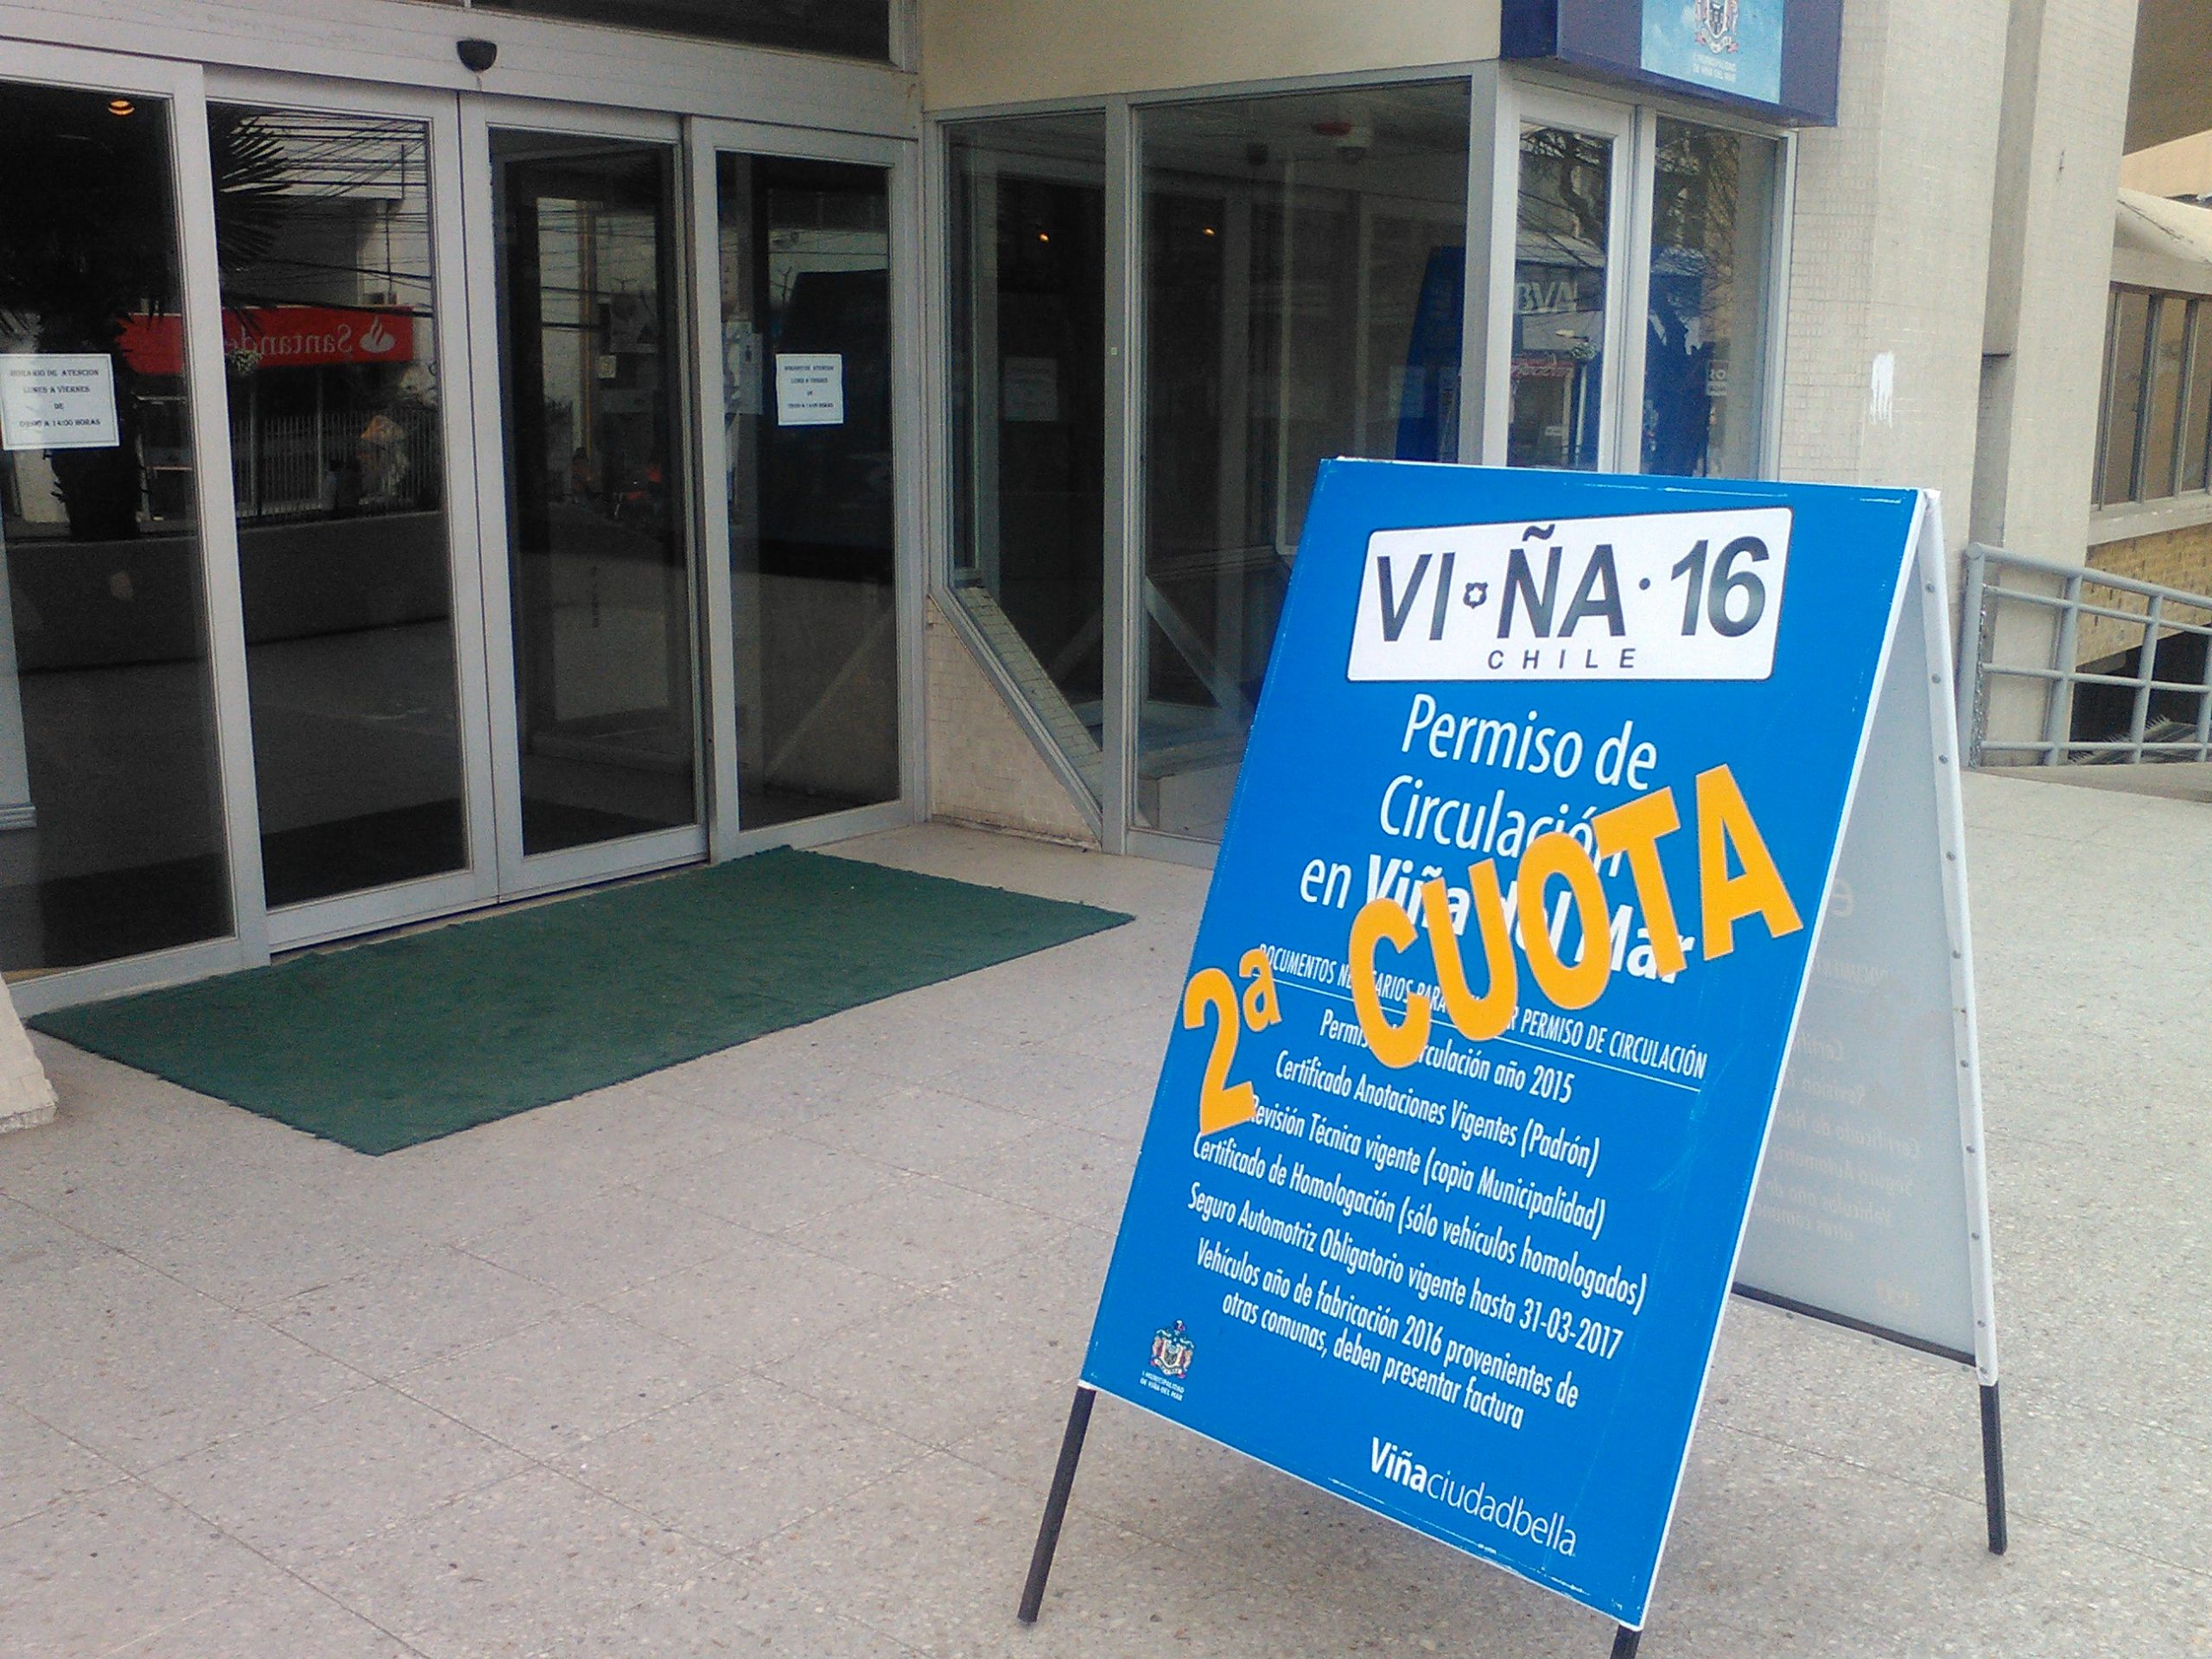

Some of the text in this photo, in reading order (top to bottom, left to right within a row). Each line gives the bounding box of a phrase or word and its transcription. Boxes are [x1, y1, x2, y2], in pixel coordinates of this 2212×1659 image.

[58, 385, 91, 394] VIERNES
[1487, 648, 1637, 670] CHILE
[1402, 693, 1657, 791] Permiso de
[1300, 857, 1351, 909] en
[1349, 763, 1803, 1068] CUOTA
[1319, 1008, 1576, 1104] Permi rculación año 2015
[1337, 963, 1413, 1004] NEARIOS
[1520, 1008, 1583, 1048] PERMISO
[1585, 1025, 1607, 1054] DE
[1609, 1030, 1708, 1079] CIRCULACIÓN
[1275, 1049, 1600, 1179] Certificado Anotaciones Vigentes (Padrón)
[1308, 1112, 1361, 1156] Técnica
[1364, 1133, 1421, 1175] vigente
[1423, 1147, 1474, 1193] (copia
[1478, 1170, 1607, 1241] Municipalidad)
[1188, 1181, 1624, 1361] Seguro Automotriz Obligatorio vigente hasta 31-03-2017
[1193, 1131, 1649, 1317] Certificado de Homologación (sólo vehículos homologados)
[1197, 1236, 1580, 1409] Vehículos año de fabricación 2016 provenientes de
[1222, 1293, 1525, 1430] otras comunas, deben presentar factura
